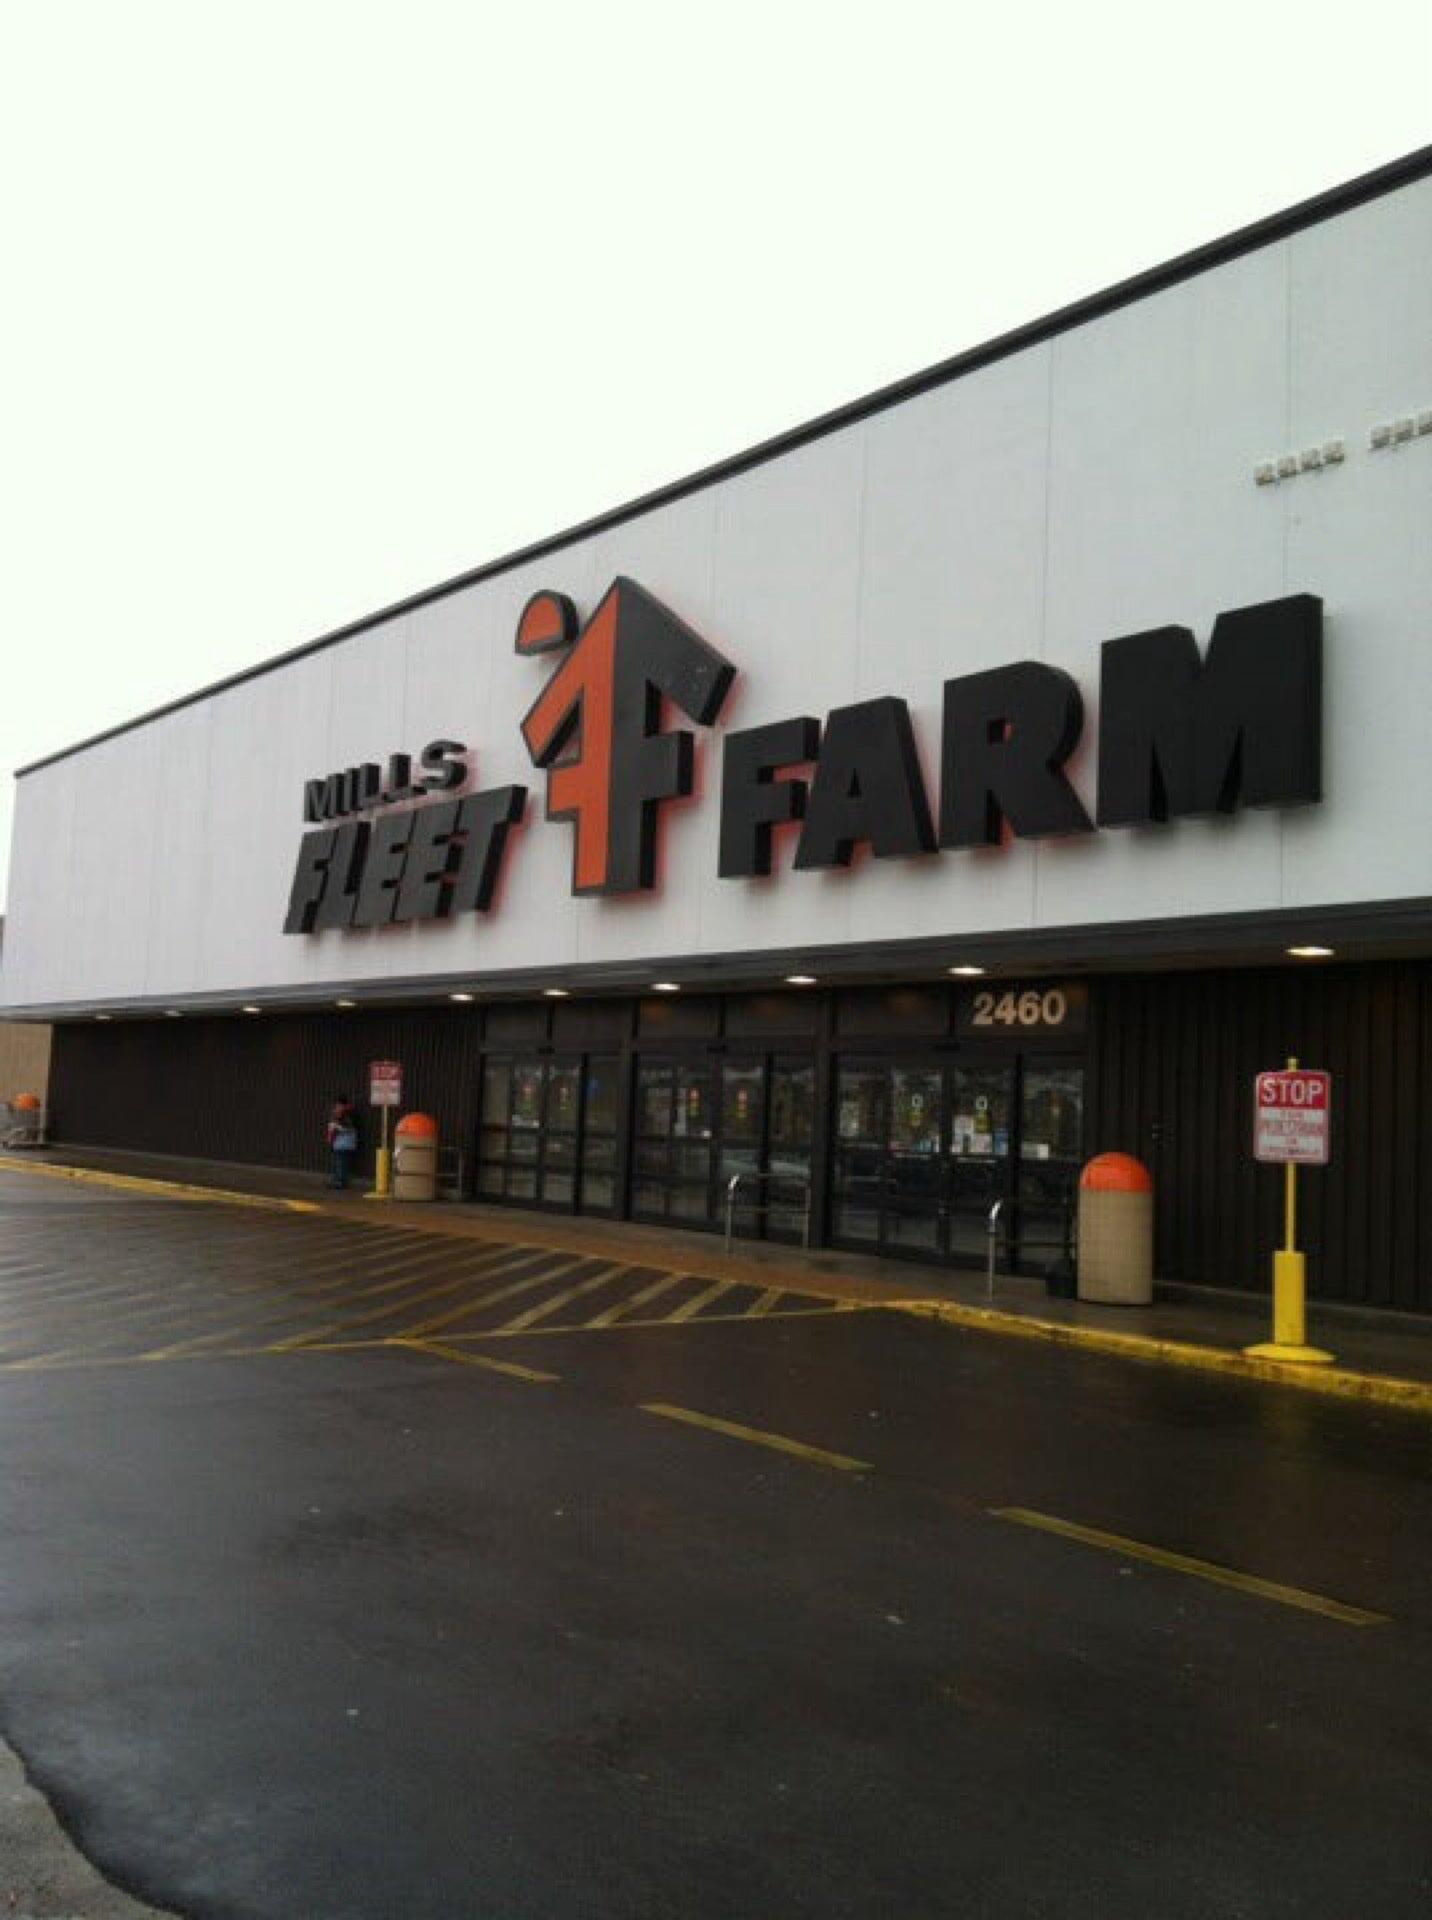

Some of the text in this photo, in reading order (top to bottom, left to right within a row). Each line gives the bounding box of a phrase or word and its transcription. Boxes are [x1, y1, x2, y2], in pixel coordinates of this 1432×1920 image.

[283, 574, 1325, 935] FLEET 4 FARM
[303, 739, 468, 821] MILLS
[972, 990, 1066, 1025] 2460
[1262, 1079, 1324, 1105] STOP
